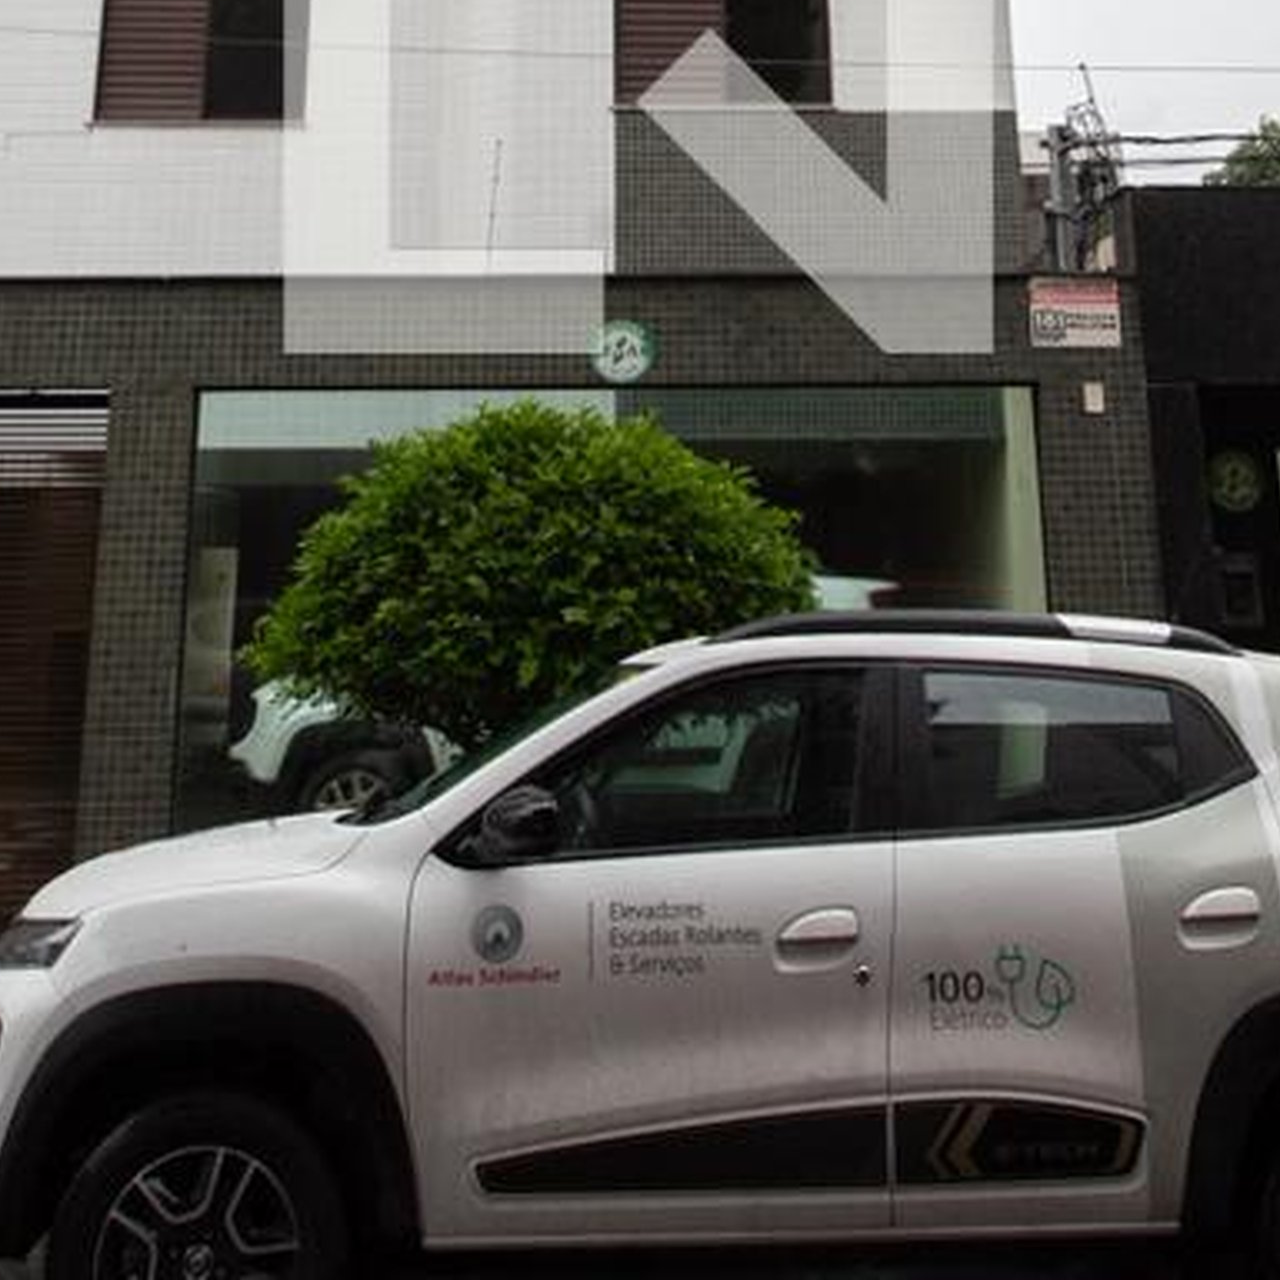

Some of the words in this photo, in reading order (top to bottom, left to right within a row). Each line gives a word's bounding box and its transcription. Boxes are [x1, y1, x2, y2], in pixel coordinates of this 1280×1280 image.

[609, 900, 705, 921] Elevadores
[609, 926, 681, 947] Escadas
[685, 924, 763, 946] Rolantes
[629, 953, 706, 979] Serviços
